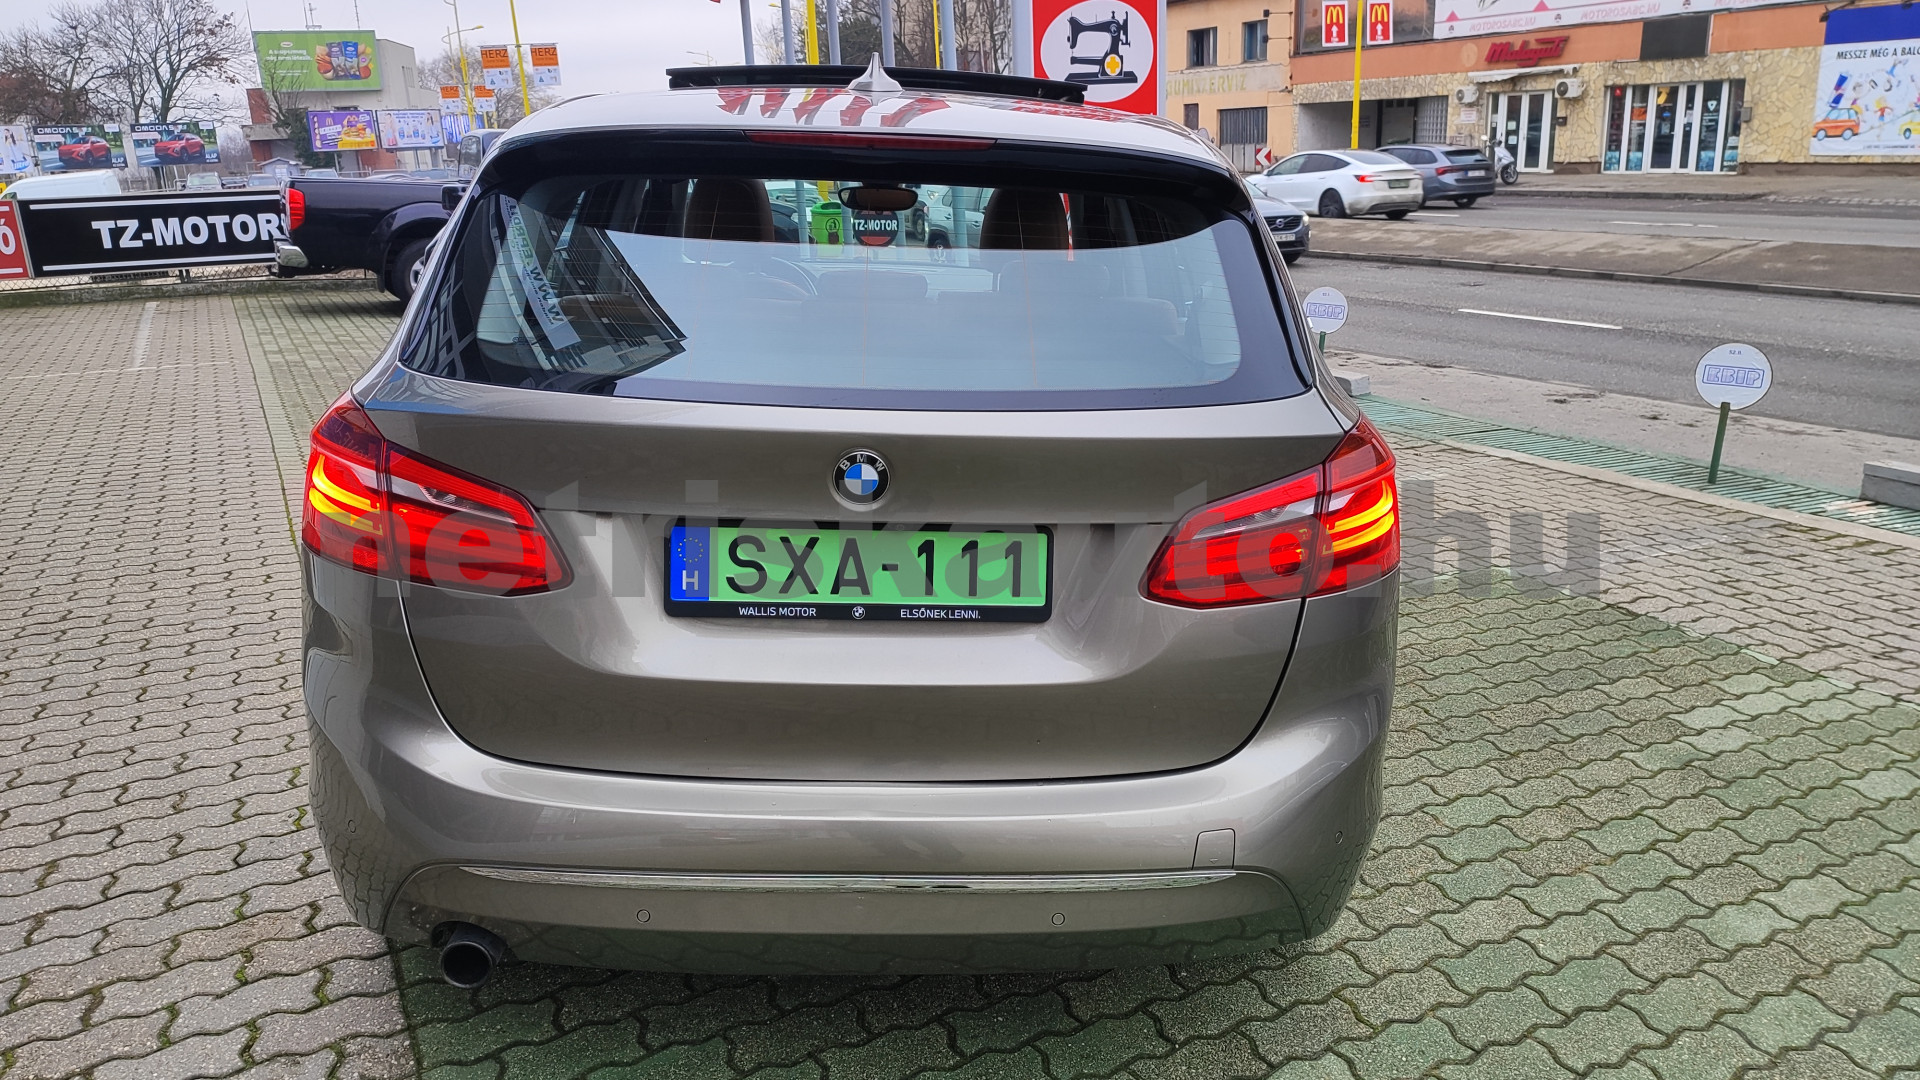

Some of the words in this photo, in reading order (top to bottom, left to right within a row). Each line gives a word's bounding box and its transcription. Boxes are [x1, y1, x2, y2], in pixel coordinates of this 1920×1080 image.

[480, 49, 508, 59] HERZ
[530, 47, 557, 57] HERZ
[1836, 49, 1867, 60] MESSZE
[1869, 45, 1889, 58] MÉG
[1891, 48, 1898, 57] A
[91, 213, 282, 249] TZ-MOTOR
[853, 219, 898, 231] TZ-MOTOR
[839, 453, 885, 472] BMW
[725, 535, 1023, 597] SXA-111
[682, 570, 699, 591] H
[738, 606, 777, 617] WALLIS
[779, 607, 817, 617] MOTOR
[900, 607, 947, 619] ELSŐNEK
[948, 610, 981, 619] LENNI.
